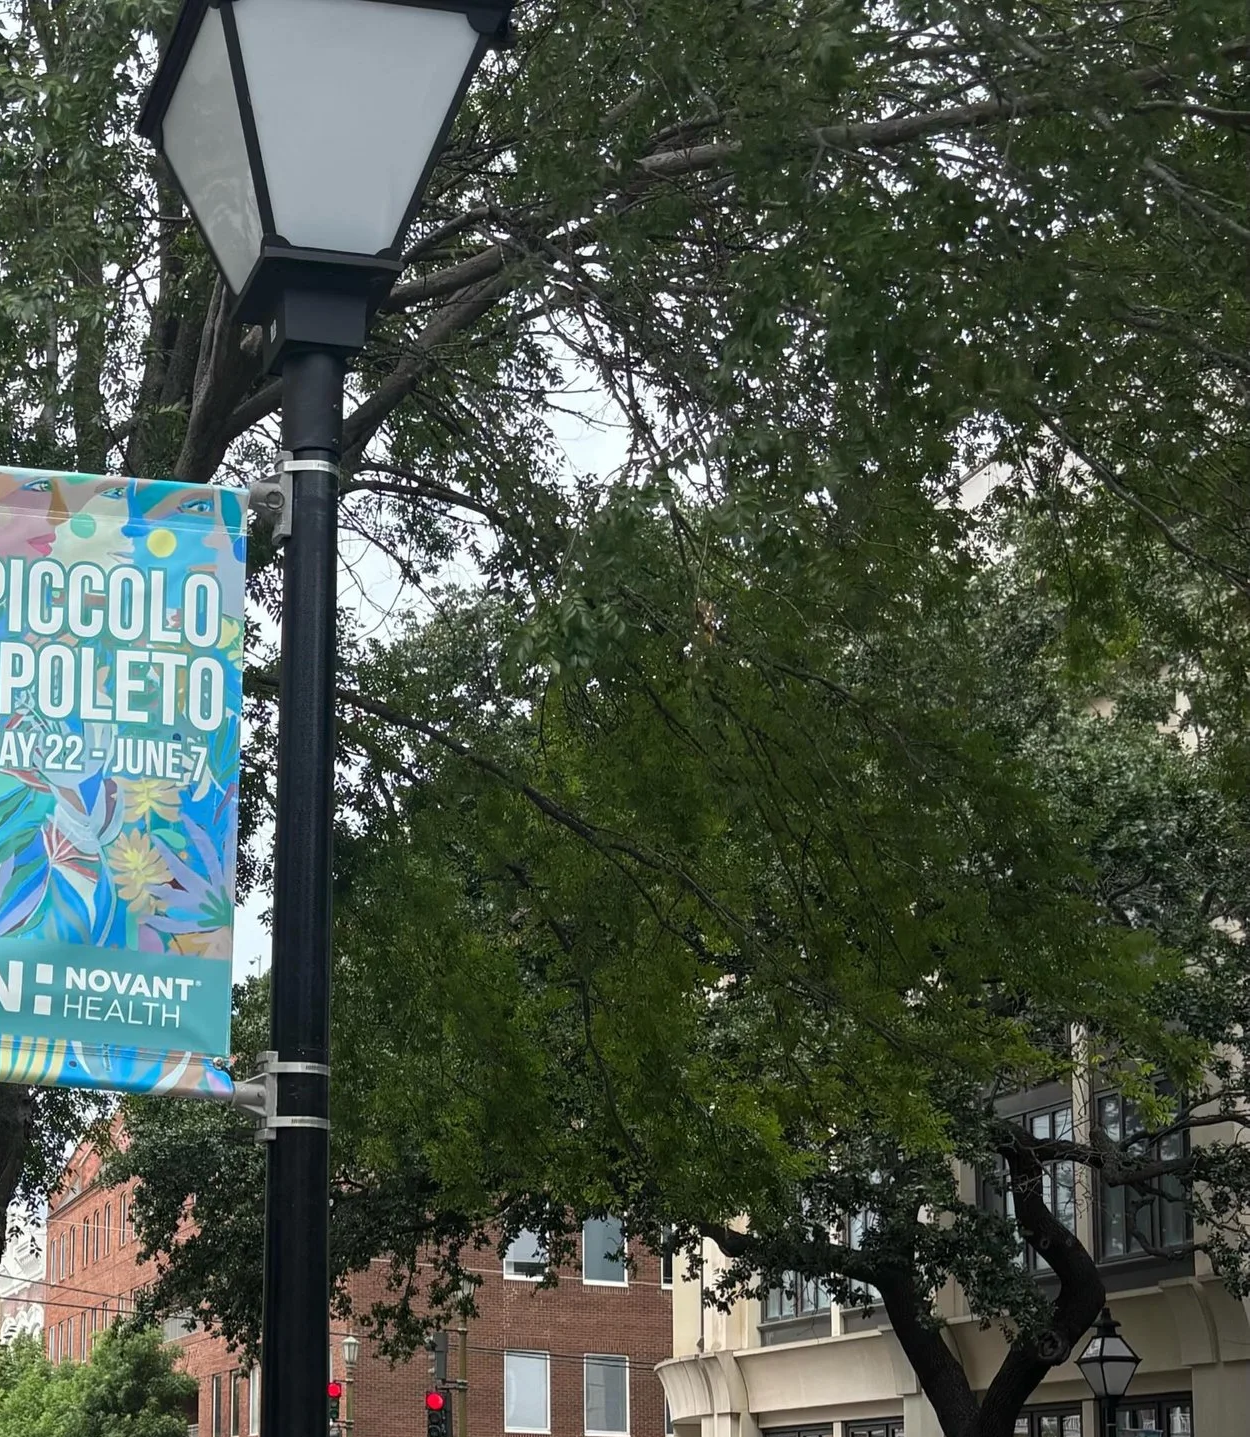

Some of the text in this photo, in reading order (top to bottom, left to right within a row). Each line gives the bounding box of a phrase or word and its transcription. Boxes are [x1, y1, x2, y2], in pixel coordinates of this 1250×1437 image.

[45, 735, 83, 770] 22
[112, 738, 182, 780] JUNE
[190, 746, 207, 782] 7
[63, 994, 180, 1028] HEALTH
